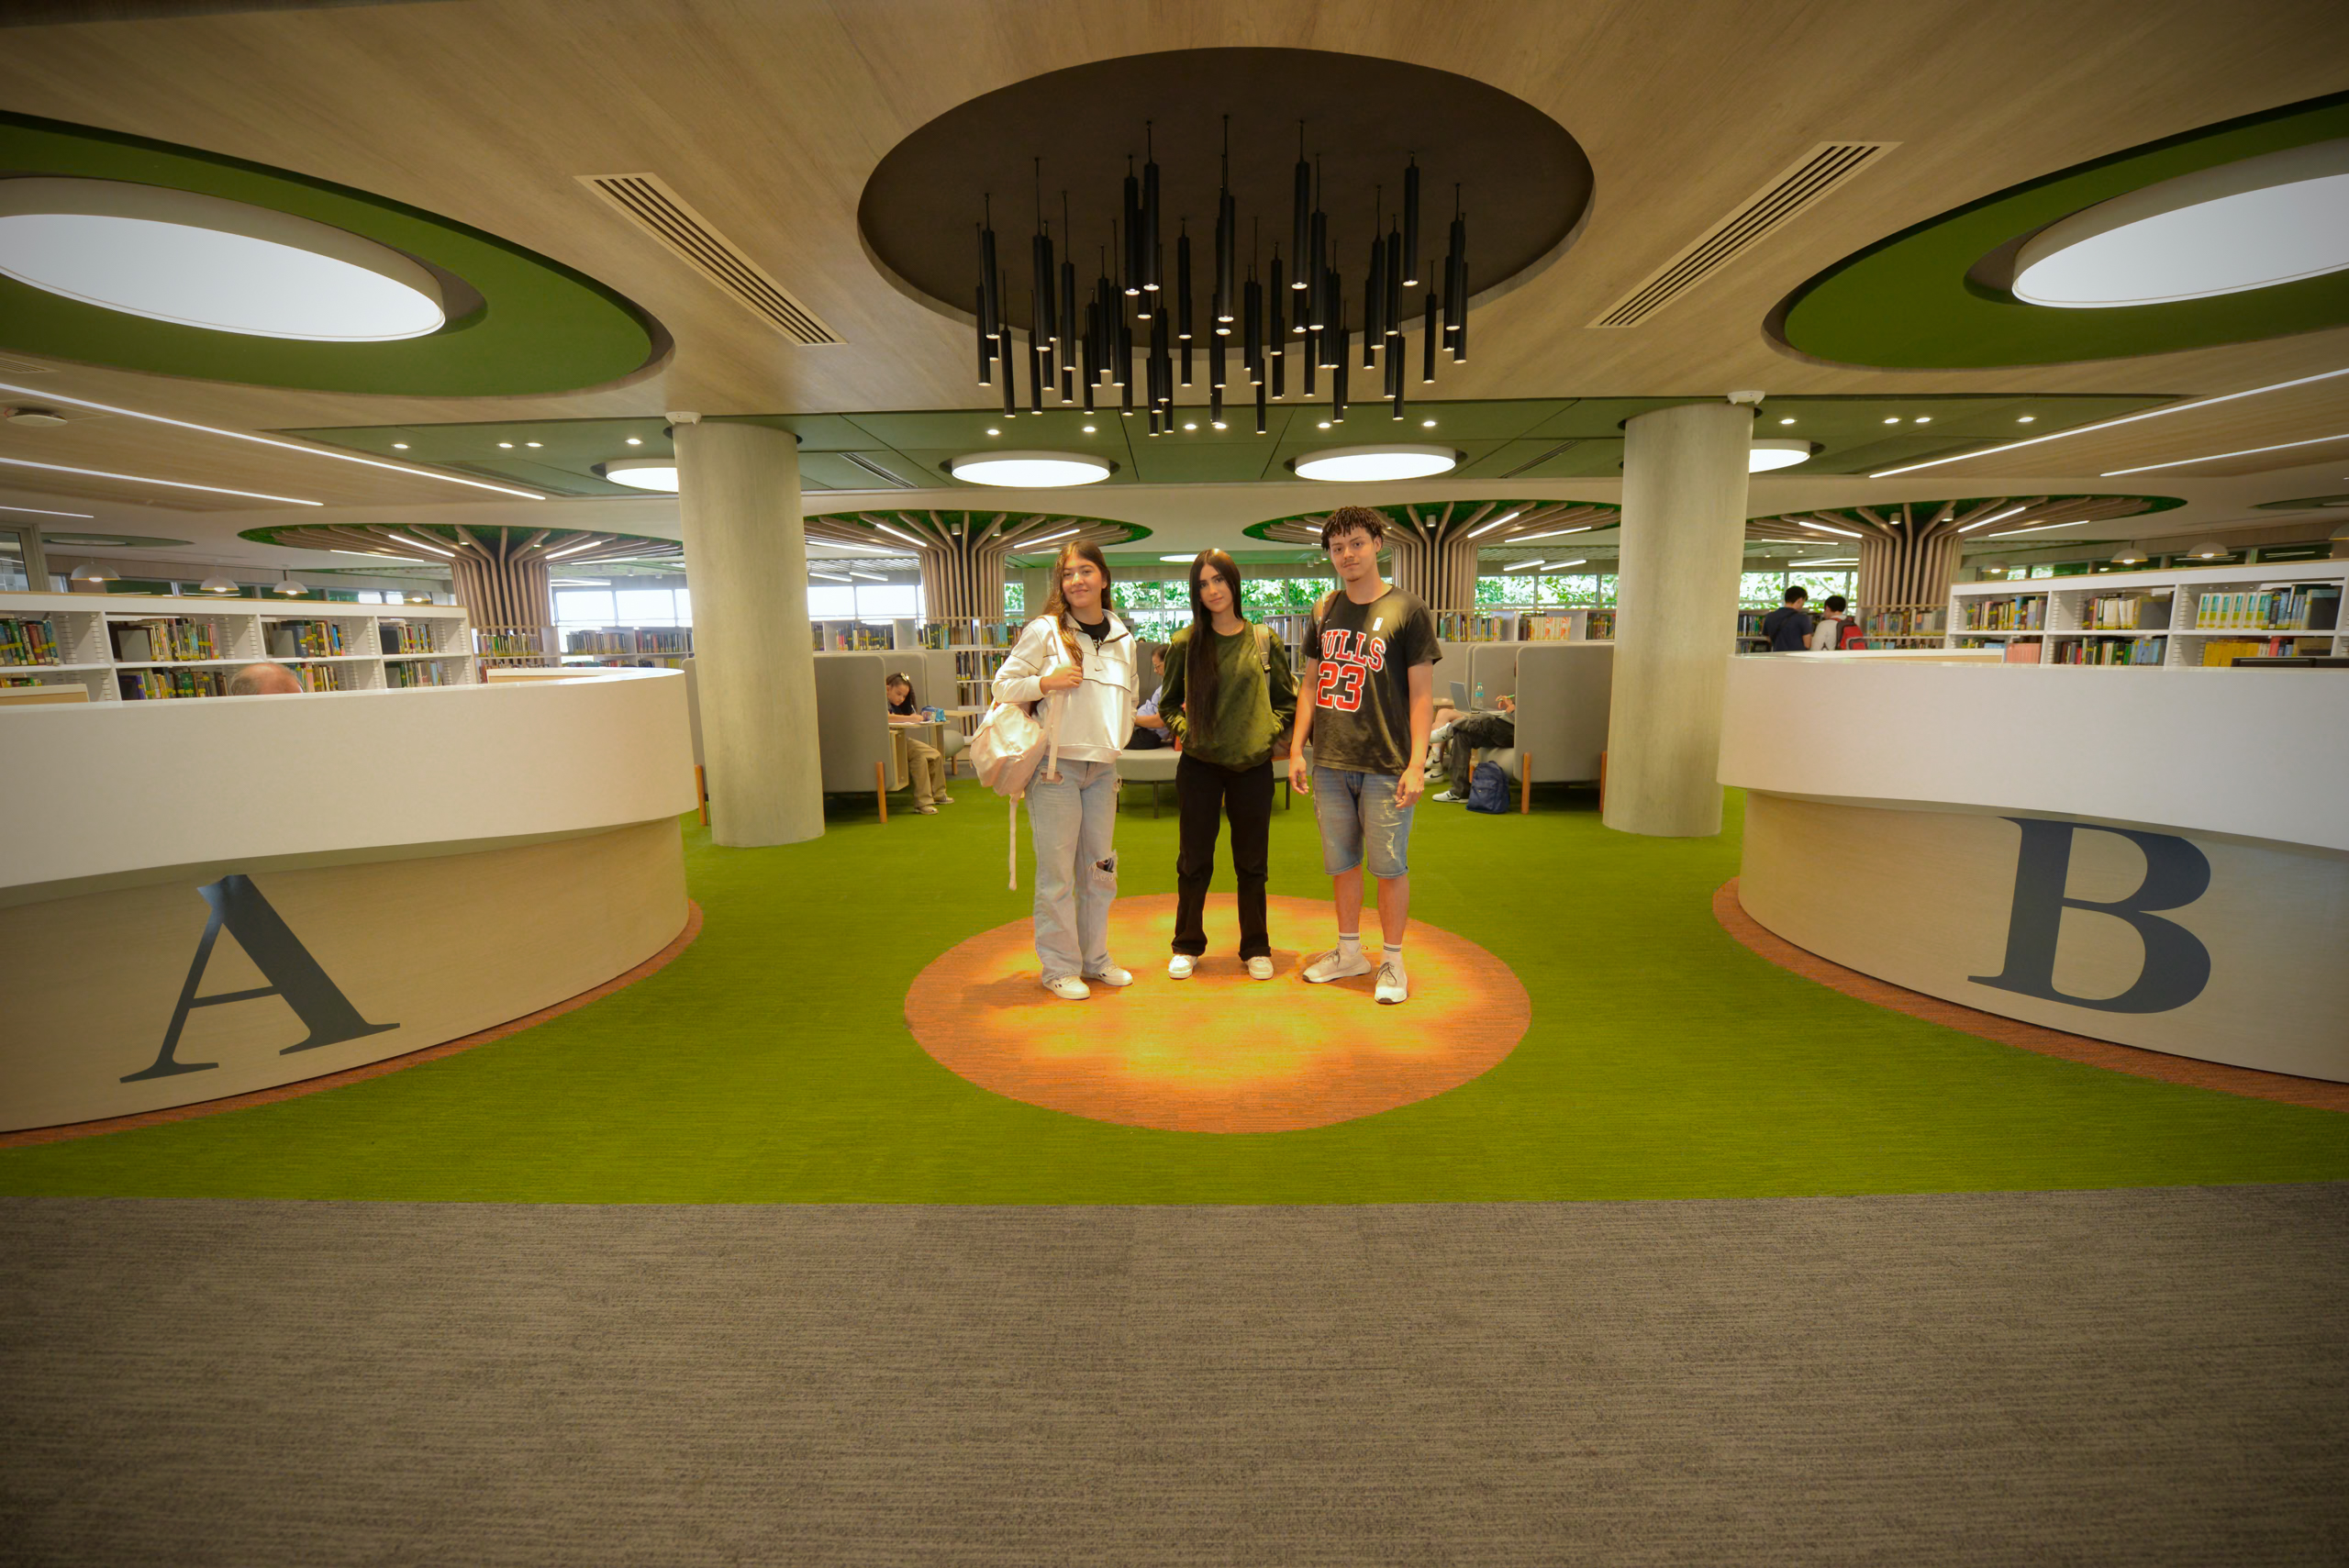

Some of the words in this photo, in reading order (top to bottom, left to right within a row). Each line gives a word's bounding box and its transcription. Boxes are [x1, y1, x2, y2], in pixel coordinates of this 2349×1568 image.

[1317, 662, 1366, 712] 23
[1321, 628, 1386, 672] ULLS
[1967, 816, 2210, 1014] B
[119, 874, 400, 1084] A
